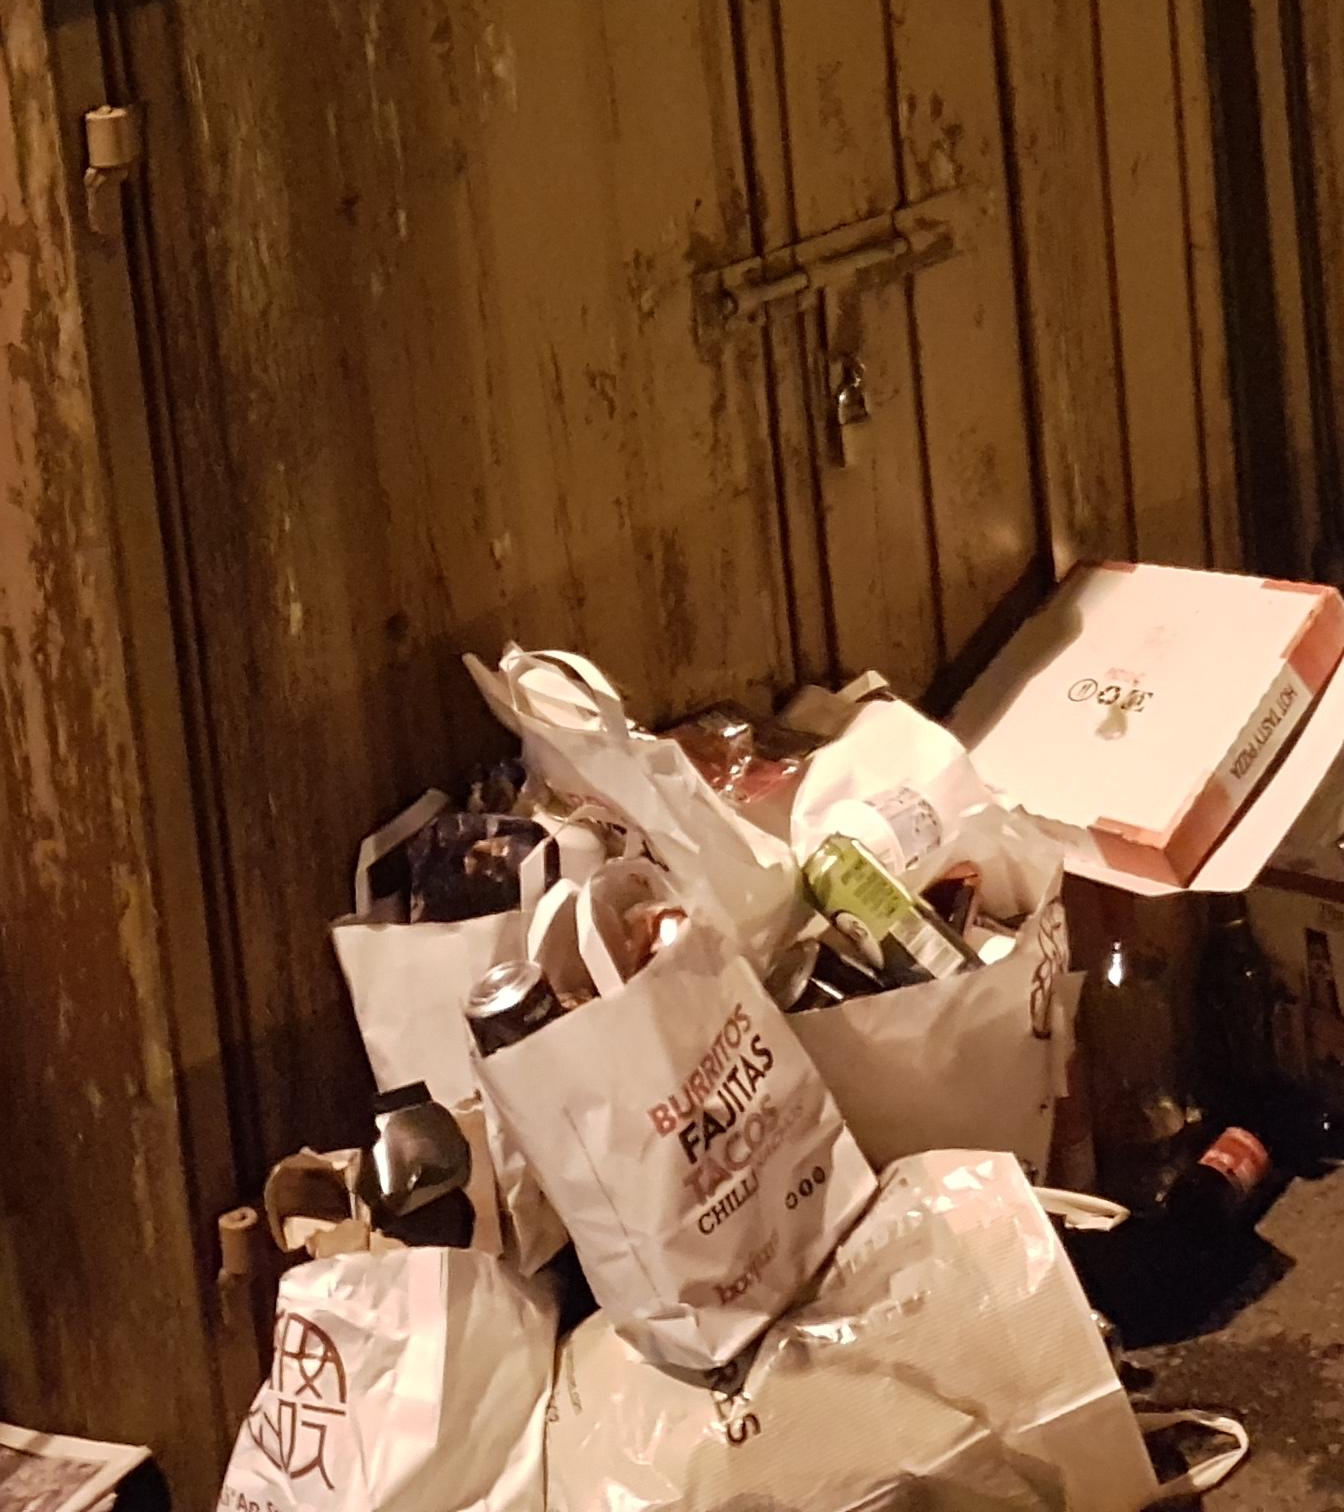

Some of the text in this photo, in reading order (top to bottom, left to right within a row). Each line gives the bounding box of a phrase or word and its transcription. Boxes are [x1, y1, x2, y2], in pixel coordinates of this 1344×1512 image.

[648, 1003, 751, 1137] BURRITOS
[678, 1035, 775, 1165] FAJITAS
[683, 1093, 780, 1210] TACOS
